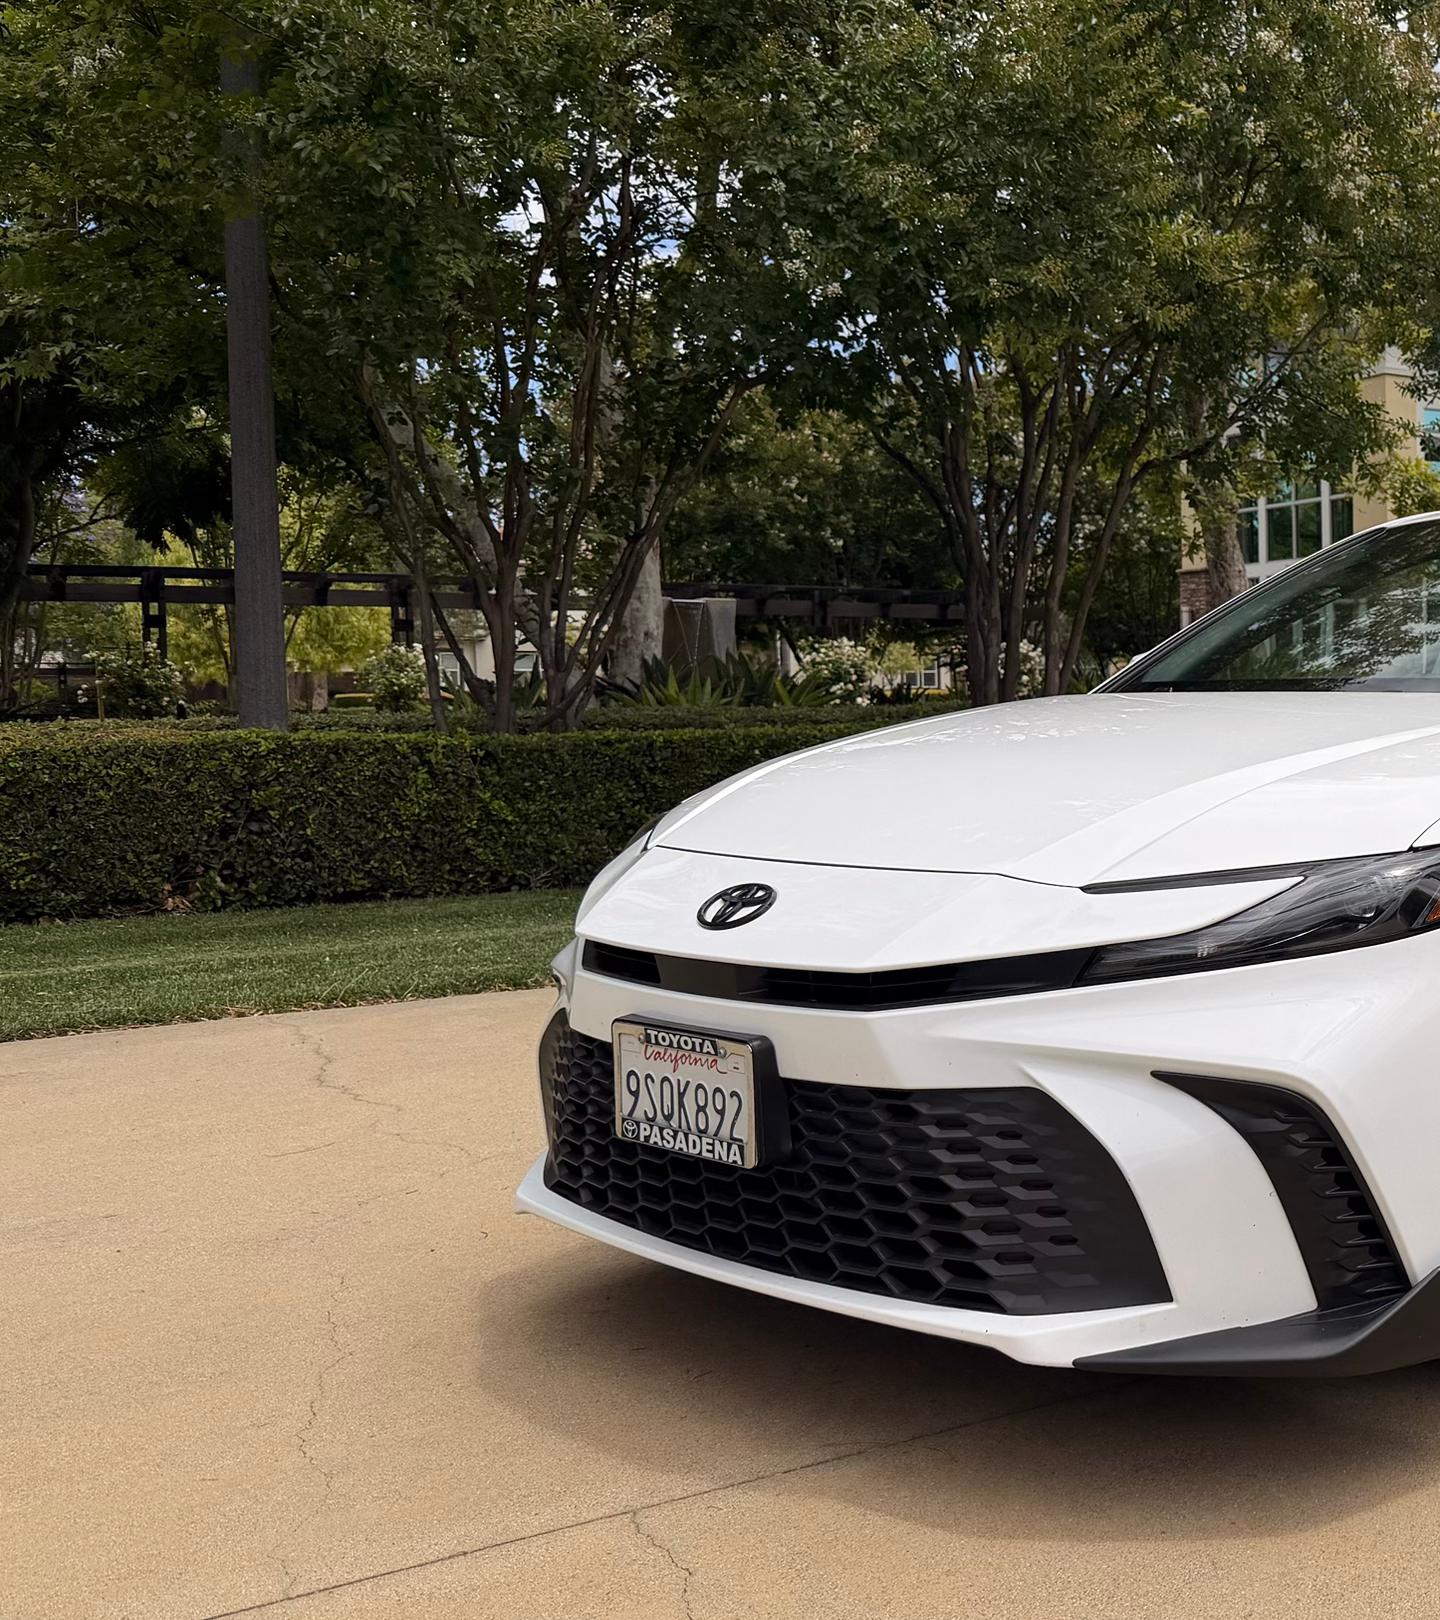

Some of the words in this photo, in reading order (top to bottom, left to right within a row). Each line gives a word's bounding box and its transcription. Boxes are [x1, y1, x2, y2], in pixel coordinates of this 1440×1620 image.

[643, 1044, 727, 1073] California
[646, 1030, 716, 1055] TOYOTA
[626, 1069, 744, 1142] 9SQK892
[639, 1122, 743, 1165] PASADENA
